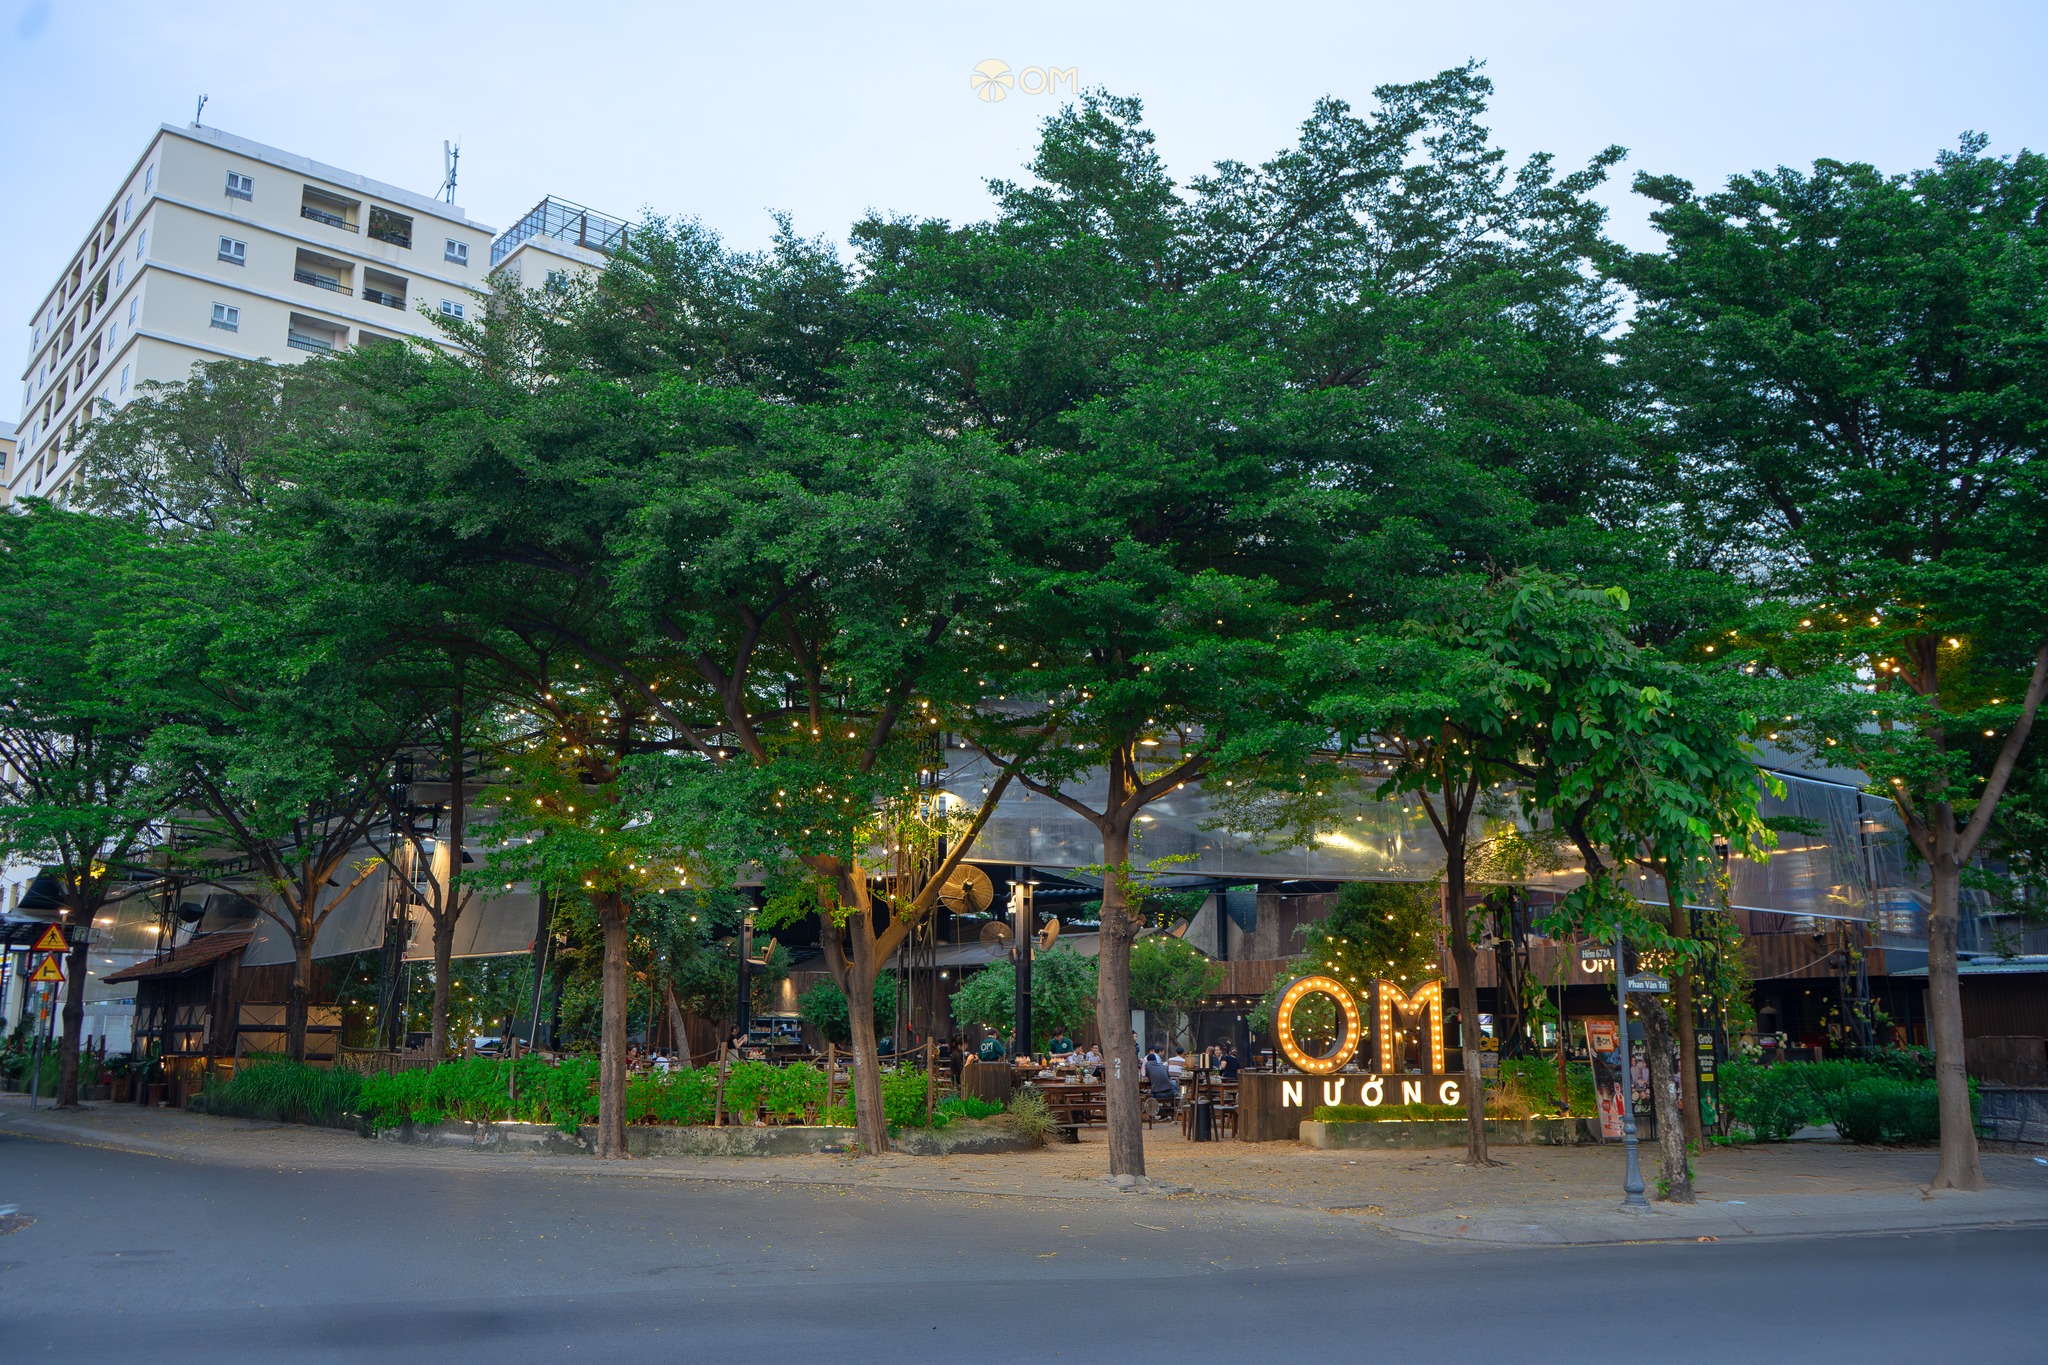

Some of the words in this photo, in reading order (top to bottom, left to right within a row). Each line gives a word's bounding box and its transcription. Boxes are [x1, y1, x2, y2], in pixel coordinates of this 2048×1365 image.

[1596, 948, 1611, 957] 672A
[1628, 980, 1644, 989] Phan
[1645, 980, 1657, 989] Văn
[1658, 980, 1668, 990] Trị
[1271, 975, 1445, 1074] OM
[1698, 1034, 1713, 1044] Grab
[980, 1042, 993, 1051] OM
[1114, 1057, 1121, 1079] 24
[1282, 1075, 1460, 1107] NƯỚNG
